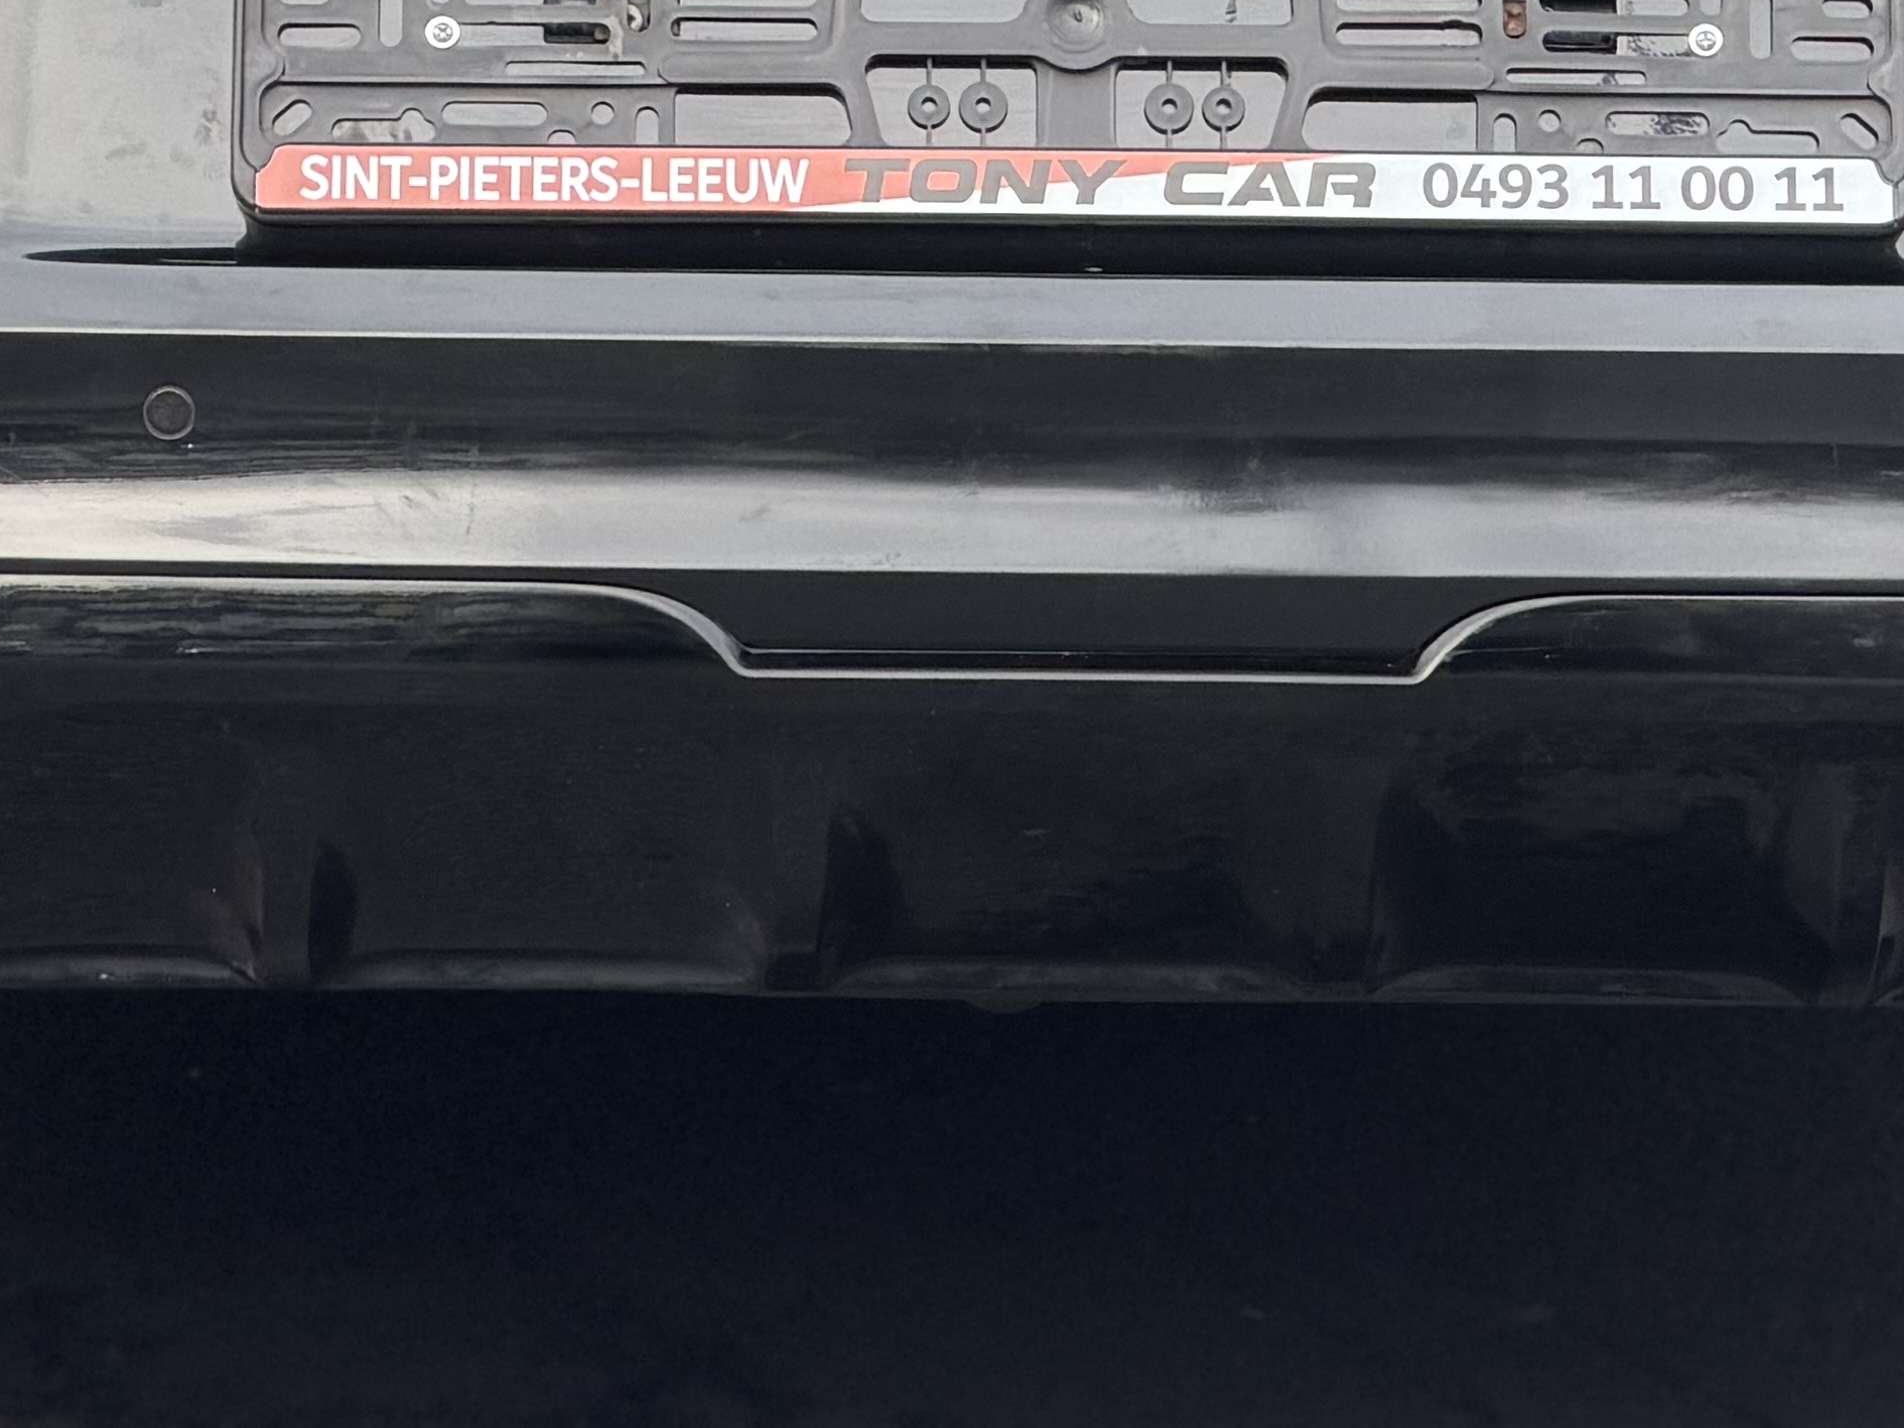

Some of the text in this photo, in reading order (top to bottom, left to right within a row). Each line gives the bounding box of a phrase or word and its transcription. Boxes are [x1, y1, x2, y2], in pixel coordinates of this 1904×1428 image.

[298, 154, 1845, 213] SINT-PIETERS-LEEUW TONY CAR 0493 11 00 11
